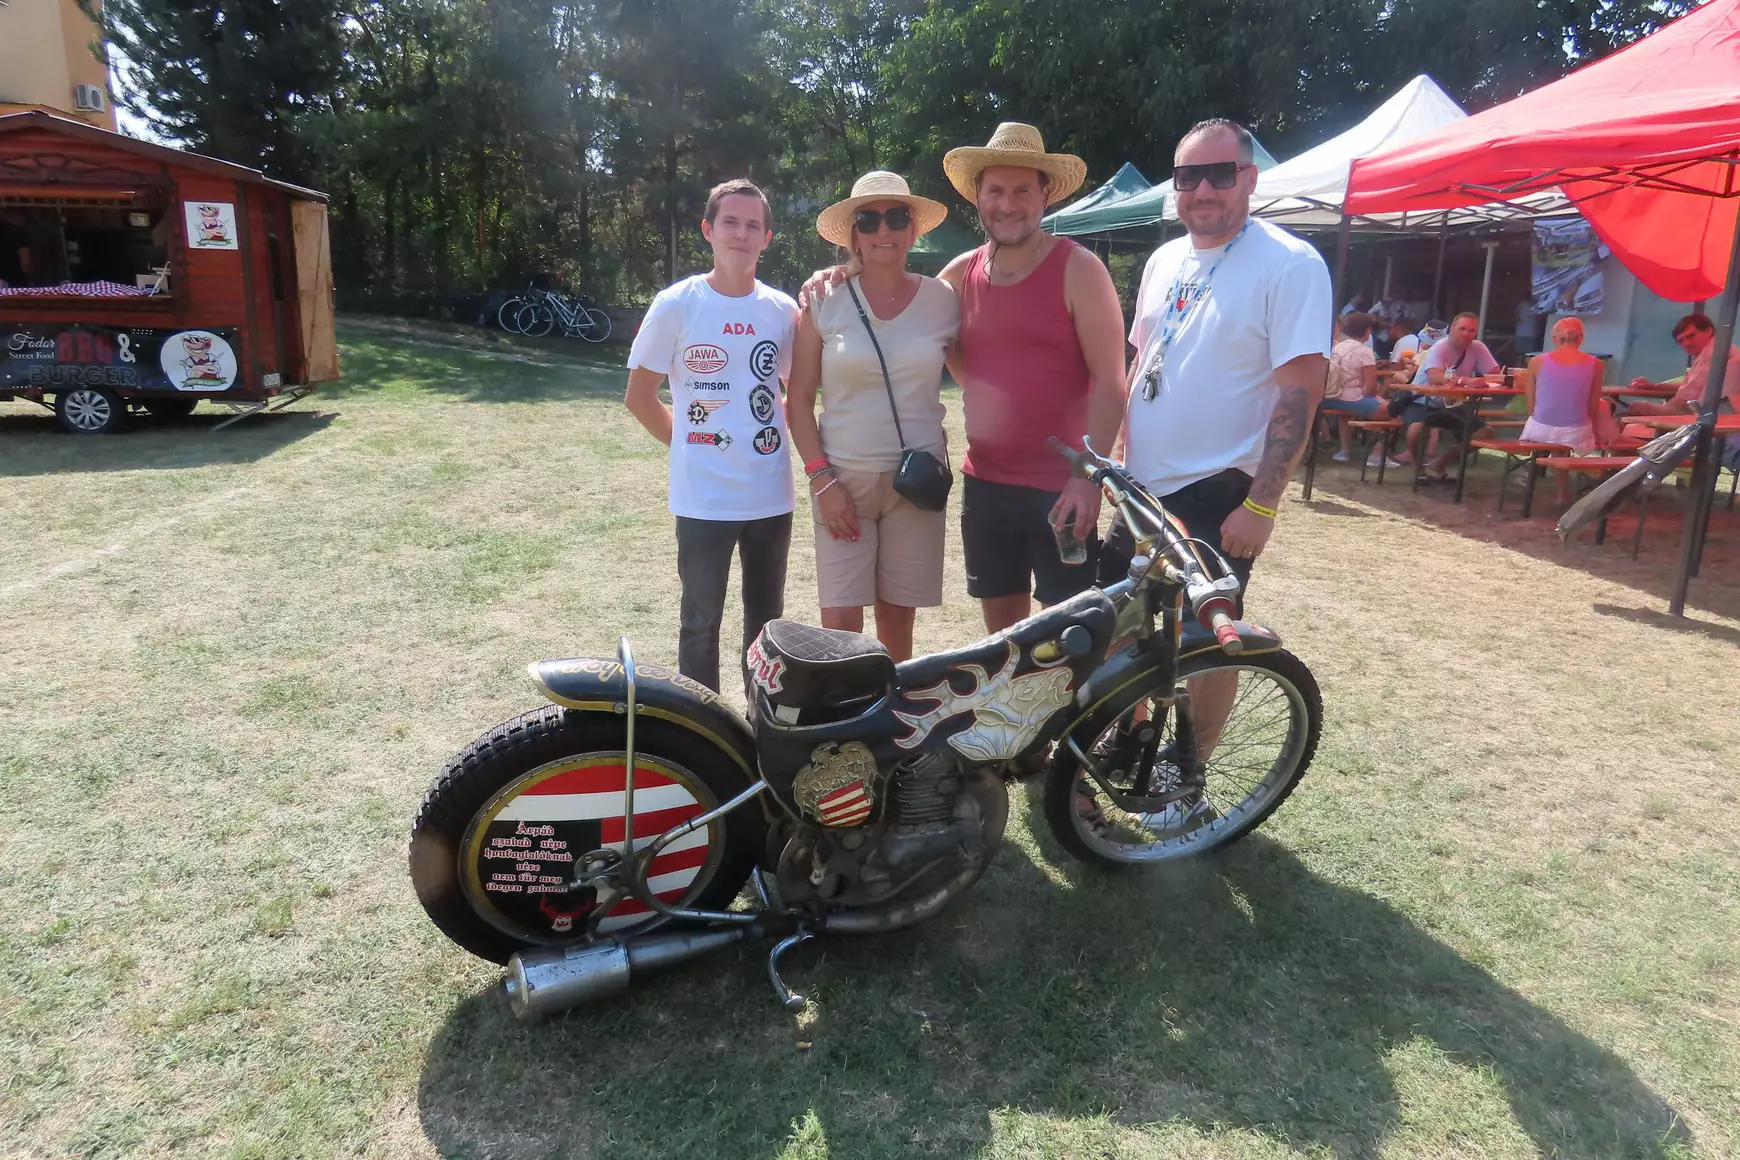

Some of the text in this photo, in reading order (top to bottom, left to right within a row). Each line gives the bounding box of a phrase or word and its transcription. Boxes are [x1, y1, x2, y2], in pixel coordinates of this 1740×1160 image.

[723, 323, 756, 336] ADA
[117, 333, 136, 363] &
[9, 351, 55, 360] Street Food
[689, 349, 719, 360] JAWA
[29, 364, 137, 386] BURGER
[688, 432, 716, 445] MZ
[492, 837, 532, 848] szabad
[492, 873, 516, 881] nem
[539, 875, 563, 885] meg
